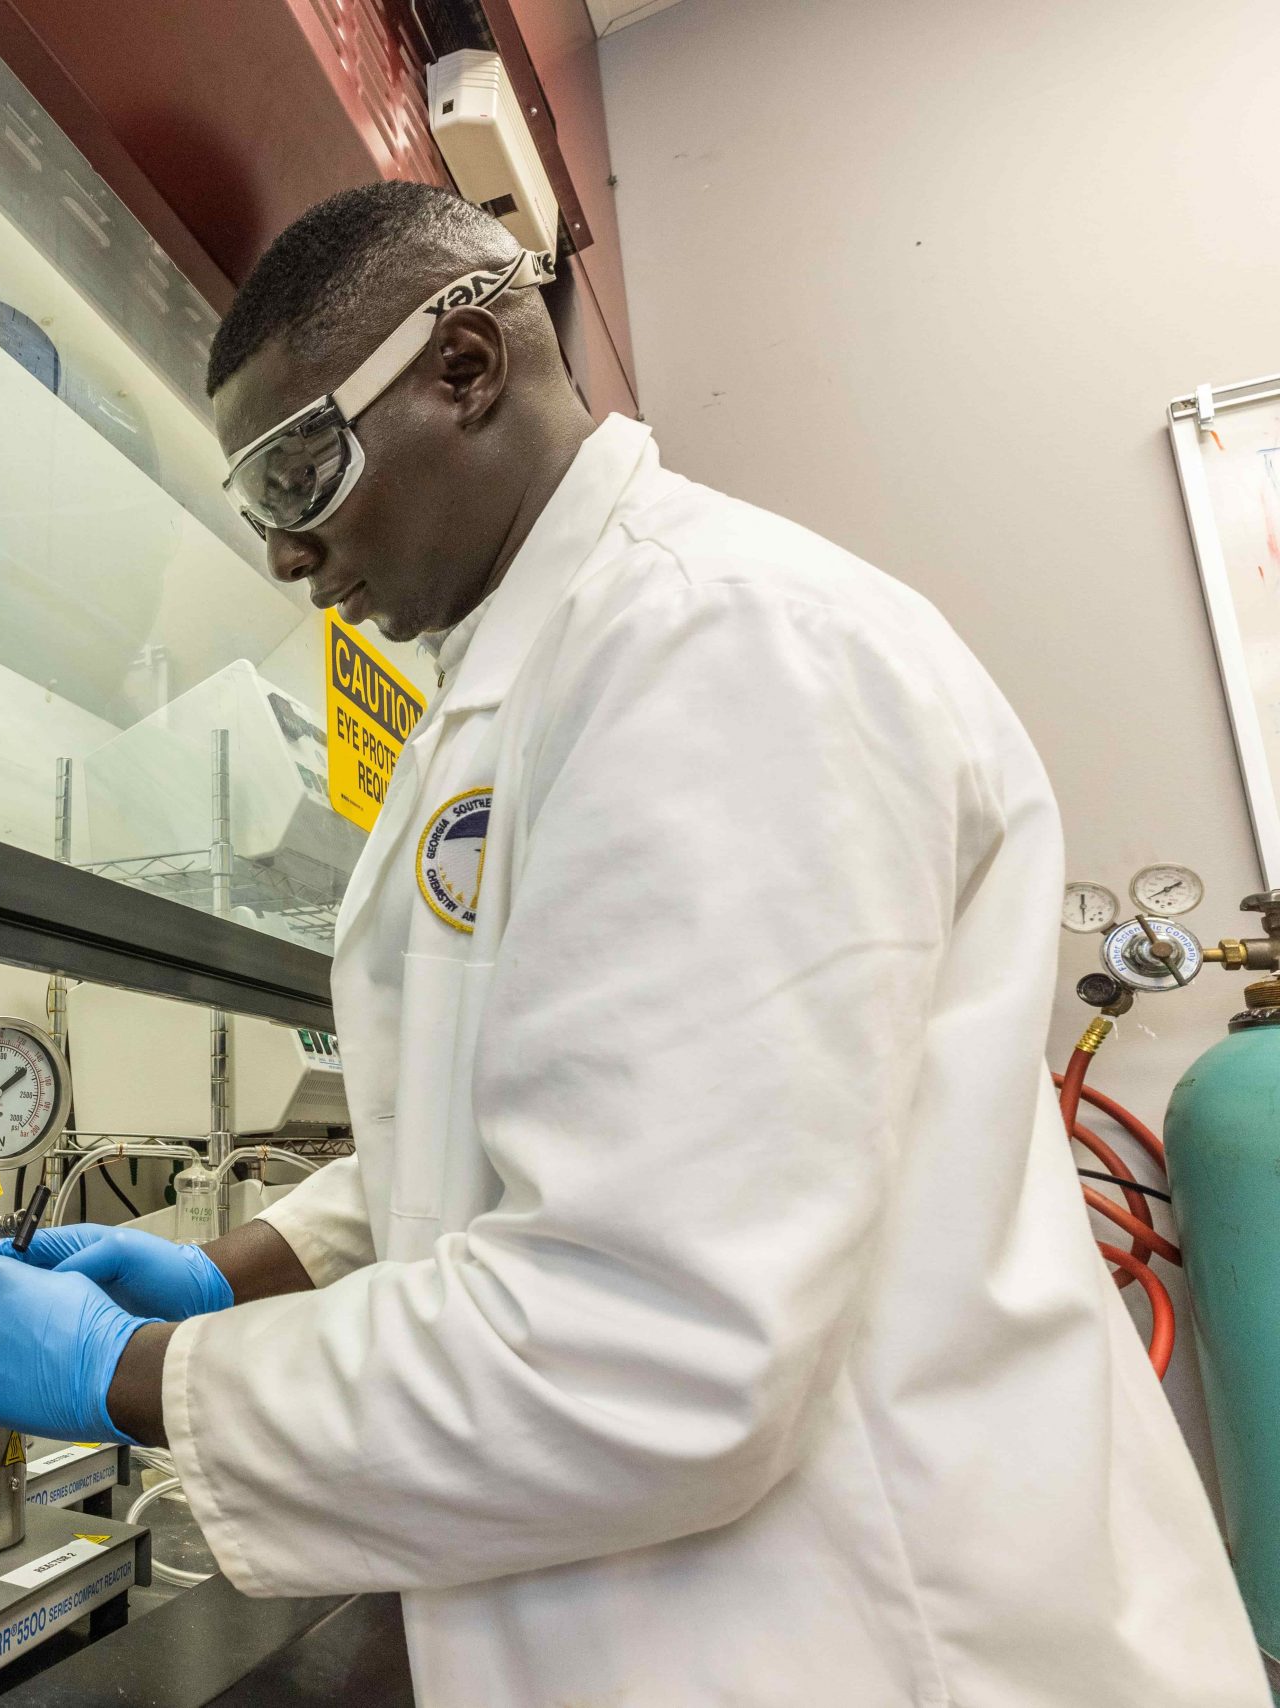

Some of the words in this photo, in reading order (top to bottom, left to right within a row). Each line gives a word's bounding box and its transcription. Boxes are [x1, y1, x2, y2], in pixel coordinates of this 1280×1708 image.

[423, 269, 509, 317] vex
[335, 638, 421, 739] CAUTION
[337, 706, 360, 751] EYE
[362, 726, 400, 776] PROTE
[358, 760, 389, 804] REQU
[426, 818, 450, 859] GEORGIA
[427, 869, 458, 912] CHEMISTRY
[1116, 923, 1162, 944] Scienic
[1165, 926, 1197, 963] Company
[1113, 946, 1127, 972] Fisher
[20, 1091, 33, 1099] 2500
[11, 1124, 20, 1132] psi
[49, 1485, 68, 1503] SERIES
[68, 1474, 92, 1494] COMPACT
[92, 1465, 115, 1484] REACTOR
[33, 1555, 71, 1573] REACTOR
[17, 1607, 47, 1645] 5500
[48, 1596, 73, 1622] SERIES
[73, 1577, 104, 1607] COMPACT
[104, 1561, 132, 1588] REACTOR
